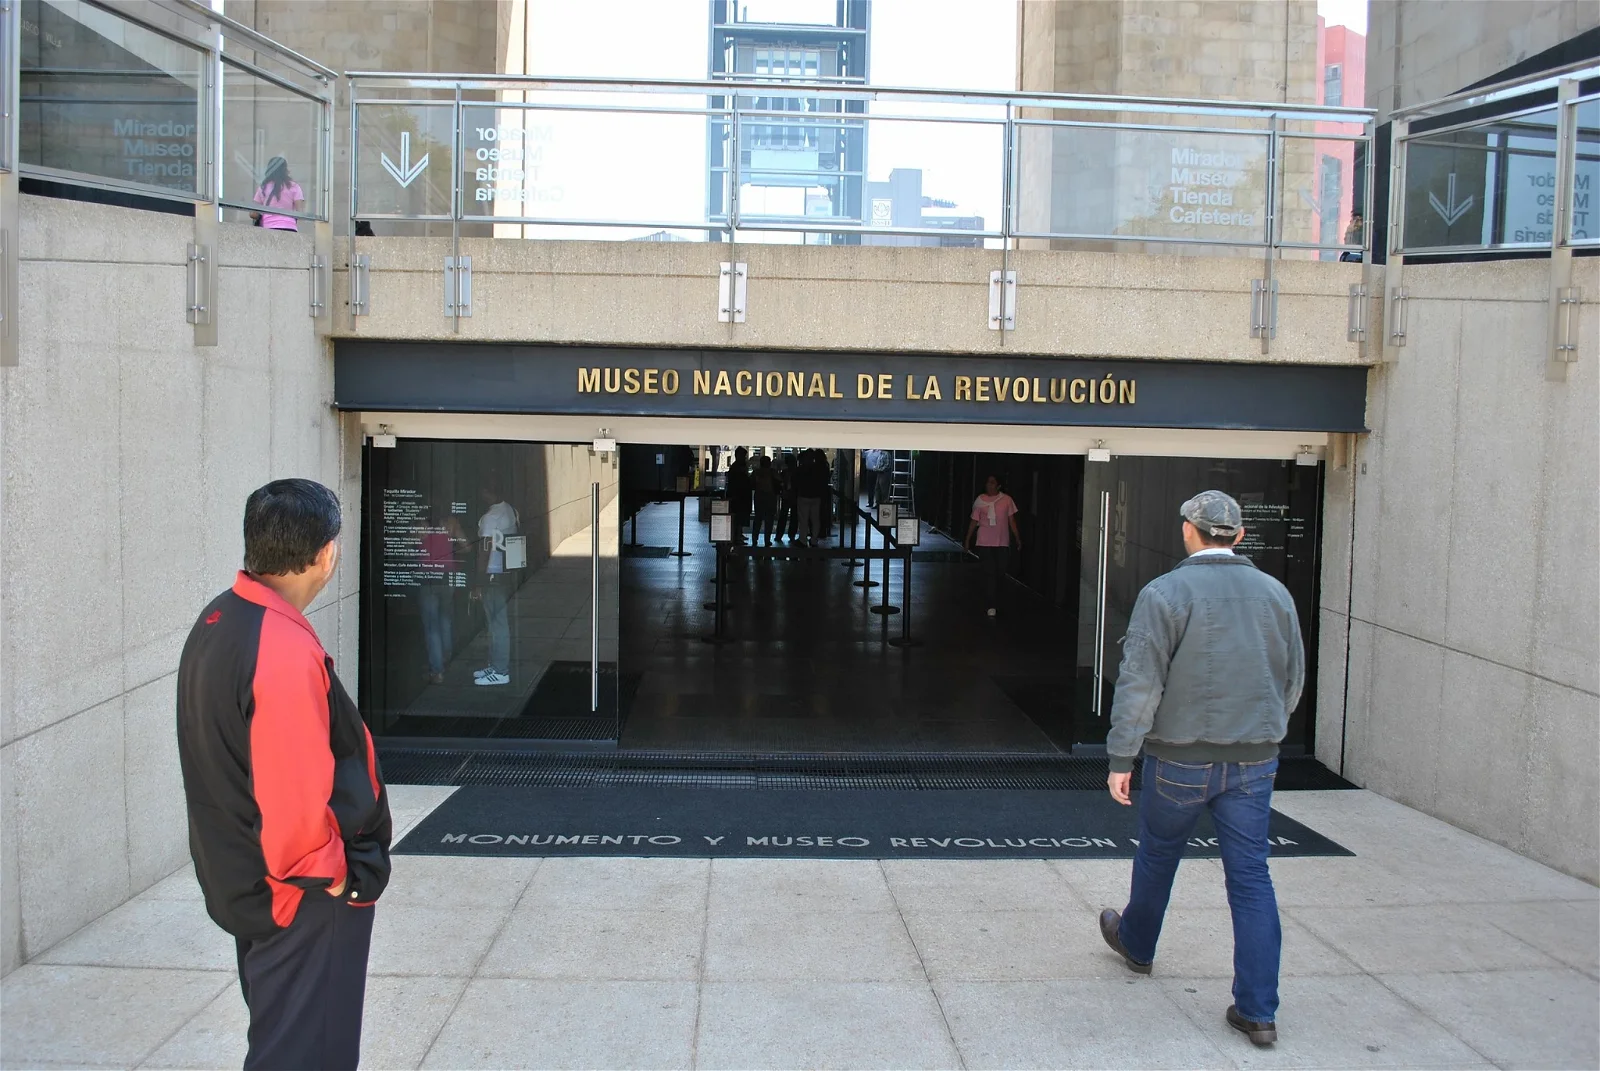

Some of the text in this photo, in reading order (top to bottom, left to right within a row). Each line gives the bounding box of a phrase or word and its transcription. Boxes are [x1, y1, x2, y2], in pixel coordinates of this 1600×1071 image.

[114, 119, 195, 137] Mirador
[124, 139, 194, 157] Museo
[1171, 147, 1244, 168] Mirador
[124, 158, 194, 177] Tienda
[1171, 167, 1236, 188] Museo
[1169, 186, 1233, 206] Tienda
[1169, 205, 1255, 226] Cafetería
[577, 367, 1137, 404] MUSEO NACIONAL DE LA REVOLUCIÓN
[440, 832, 682, 847] MONUMENTO
[703, 835, 725, 847] Y
[746, 836, 871, 848] MUSEO
[889, 835, 1118, 849] REVOLUCIÓN
